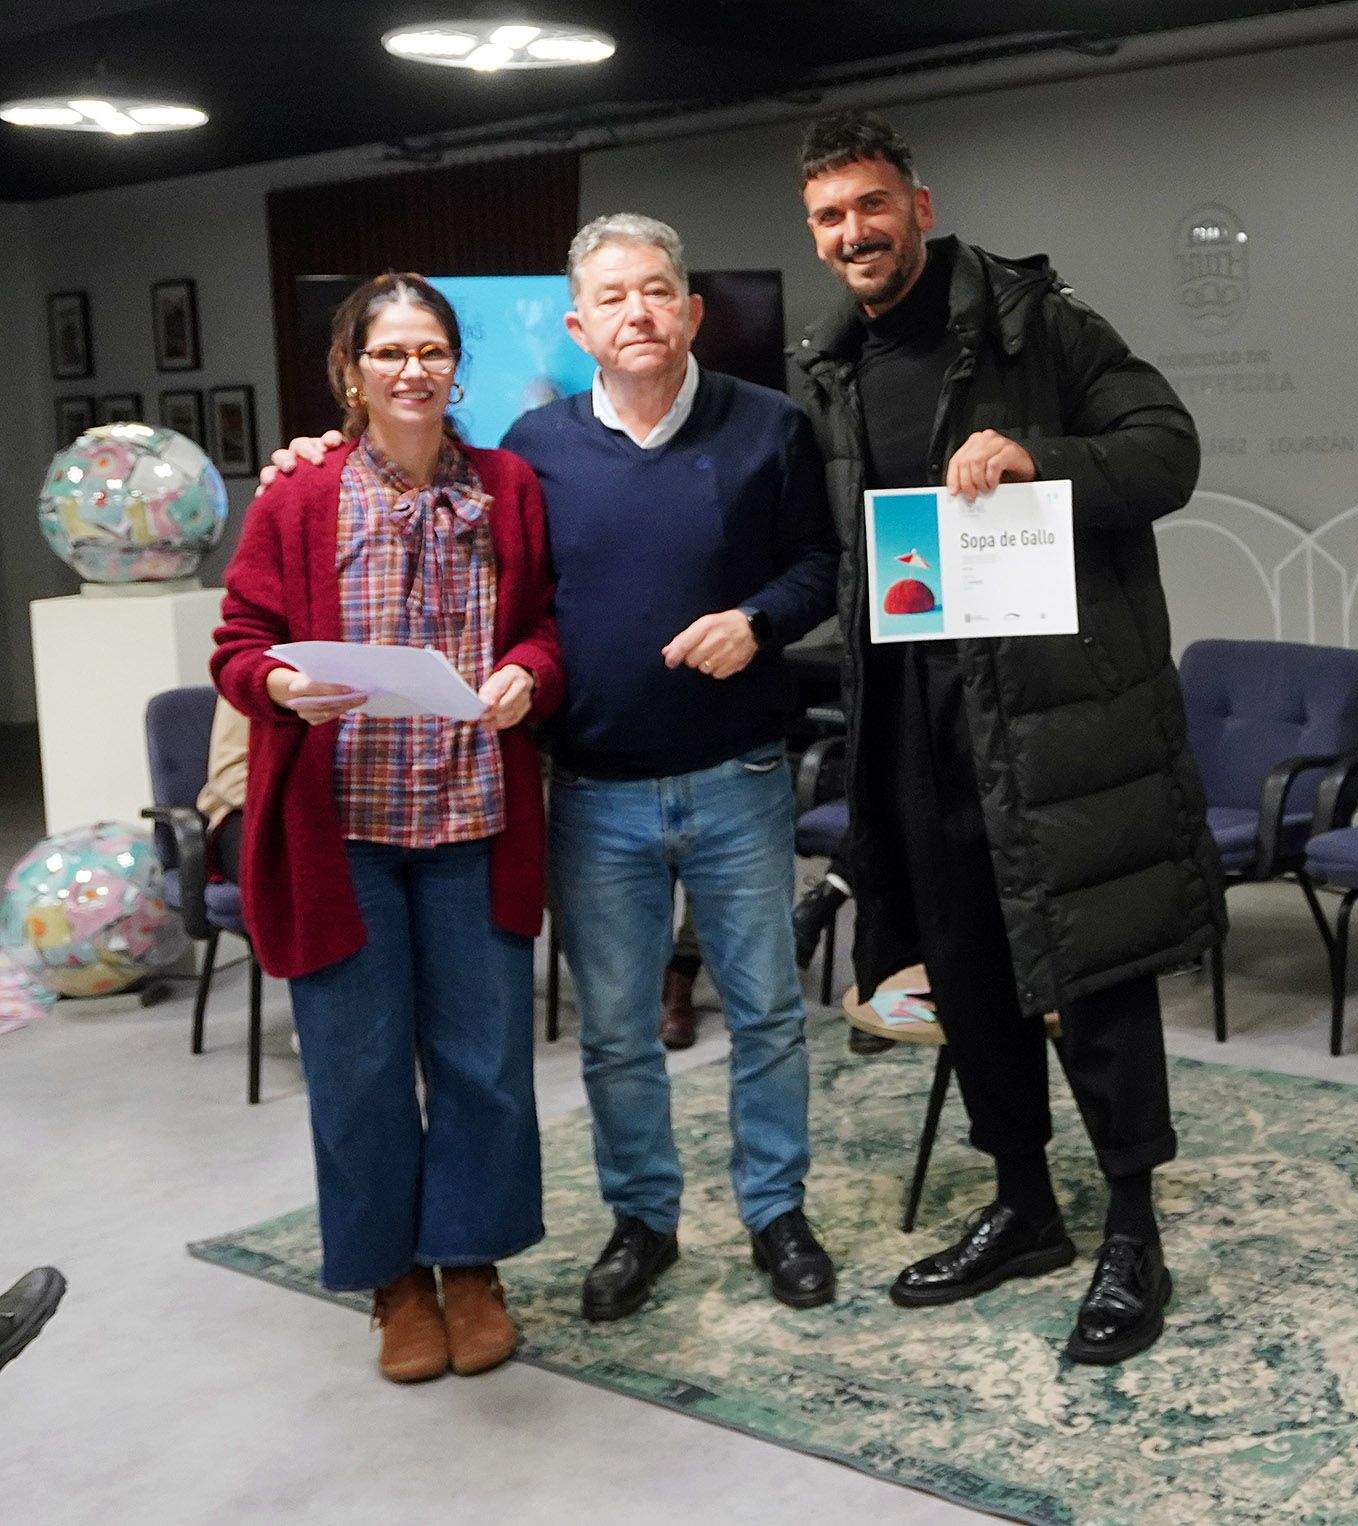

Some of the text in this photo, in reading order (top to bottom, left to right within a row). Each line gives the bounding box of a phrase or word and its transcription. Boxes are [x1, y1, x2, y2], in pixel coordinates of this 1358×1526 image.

[960, 528, 1056, 551] Sopa de Gallo
